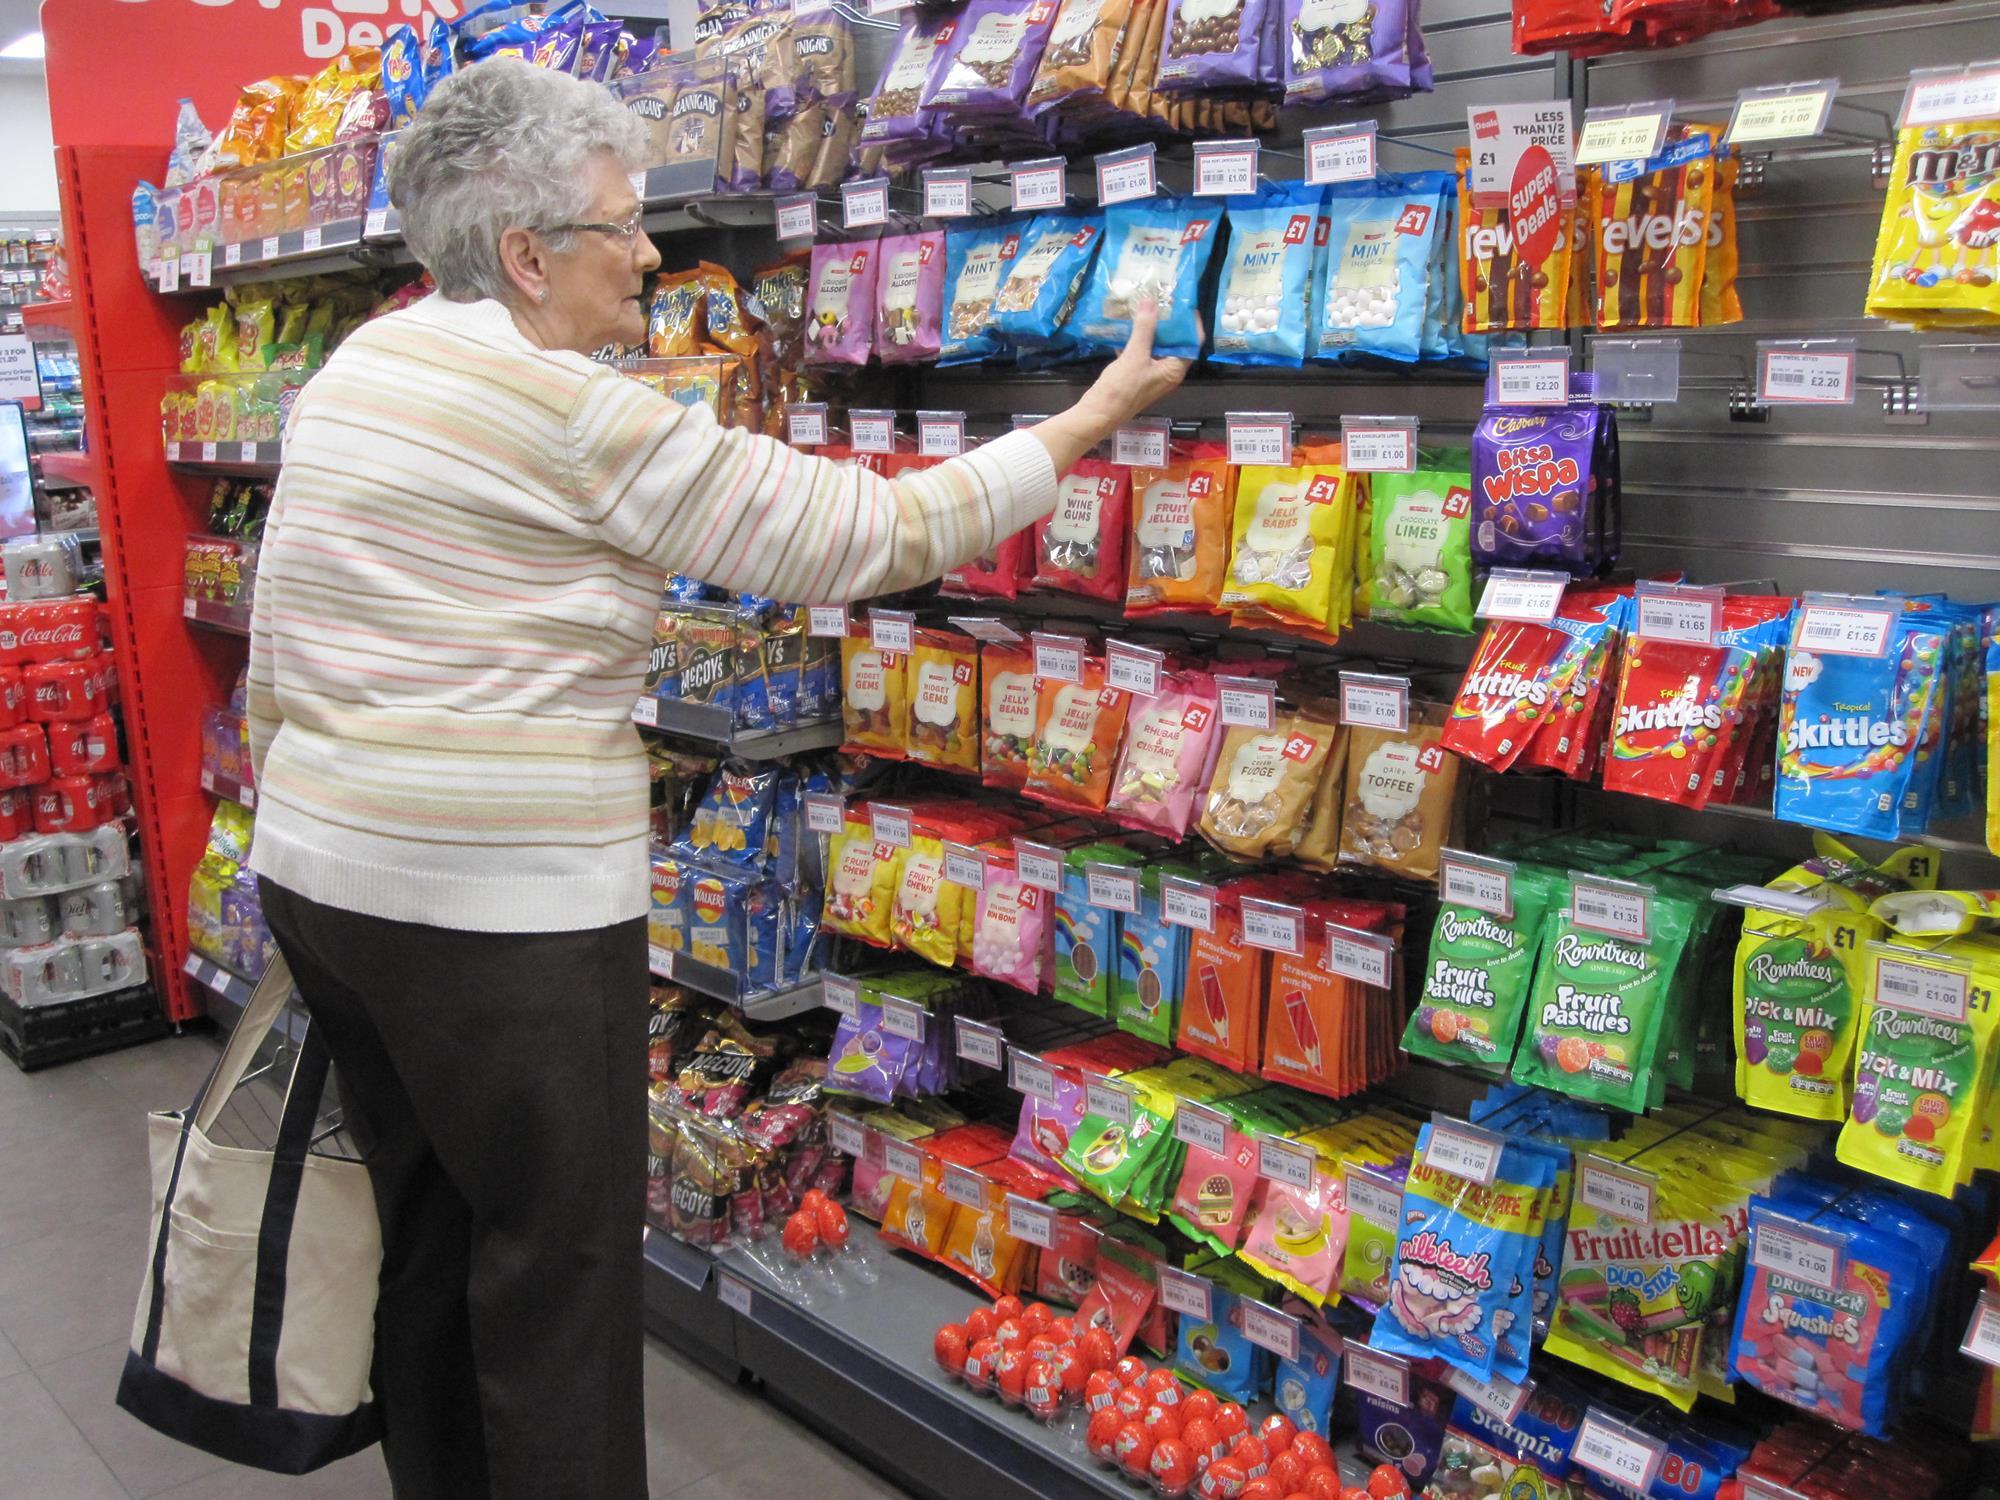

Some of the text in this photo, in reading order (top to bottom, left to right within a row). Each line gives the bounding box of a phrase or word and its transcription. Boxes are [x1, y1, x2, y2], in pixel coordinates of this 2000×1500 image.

[936, 26, 954, 42] £1
[976, 37, 1014, 46] RAISINS
[1534, 111, 1565, 123] LESS
[1780, 112, 1811, 125] £1.00
[1475, 119, 1499, 131] Deals
[1513, 123, 1566, 136] THAN 1/2
[1530, 135, 1566, 147] PRICE
[1620, 134, 1648, 146] £1.00
[1345, 154, 1368, 167] £1.00
[1479, 152, 1496, 166] £1
[1129, 177, 1147, 188] £1.00
[1228, 173, 1248, 183] £1.00
[1041, 185, 1058, 195] £1.00
[1512, 165, 1554, 217] SUPER
[950, 197, 965, 206] £1.00
[1398, 210, 1427, 231] £1
[1516, 194, 1558, 246] Deals
[1182, 223, 1204, 241] £1
[1286, 220, 1306, 239] £1
[1000, 240, 1018, 256] £1
[1132, 243, 1178, 259] MINT
[1351, 241, 1392, 258] MINT
[1242, 252, 1281, 268] MINT
[964, 260, 997, 276] MINT
[1535, 380, 1560, 391] £2.20
[1810, 377, 1841, 389] £2.20
[1492, 415, 1548, 437] Cadbury
[943, 437, 958, 447] £1.00
[1261, 444, 1281, 453] £1.00
[1144, 448, 1161, 456] £1.00
[1382, 450, 1405, 459] £1.00
[1497, 444, 1553, 472] Bitsa
[1099, 477, 1117, 496] £1
[1189, 477, 1211, 494] £1
[1483, 458, 1579, 505] Wispa
[1309, 480, 1335, 499] £1
[1066, 498, 1094, 511] WINE
[1155, 503, 1189, 513] FRUIT
[1445, 491, 1470, 513] £1
[1063, 510, 1093, 522] GUMS
[1147, 514, 1190, 524] JELLIES
[1399, 515, 1440, 526] CHOCOLATE
[1394, 524, 1439, 541] LIMES
[1526, 599, 1551, 609] £1.65
[1679, 619, 1706, 631] £1.65
[20, 623, 84, 646] Coca-Cola
[893, 634, 908, 644] £1.00
[1846, 630, 1877, 643] £1.65
[954, 667, 970, 682] £1
[1060, 662, 1077, 672] £1.00
[1791, 664, 1816, 678] NEW
[855, 671, 881, 680] MIDGET
[1133, 673, 1151, 685] £1.00
[854, 680, 880, 691] GEMS
[923, 683, 950, 694] MIDGET
[922, 693, 949, 705] GEMS
[1002, 694, 1030, 705] JELLY
[1099, 687, 1119, 706] £1
[999, 704, 1030, 716] BEANS
[1064, 707, 1092, 720] JELLY
[1249, 709, 1267, 720] £1.00
[1375, 706, 1396, 718] £1.00
[1831, 702, 1872, 713] Tropical
[1059, 717, 1089, 731] BEANS
[1183, 709, 1207, 728] £1
[1784, 715, 1908, 755] Skittles
[1136, 740, 1175, 758] CUSTARD
[1288, 738, 1313, 758] £1
[1419, 748, 1444, 768] £1
[1240, 765, 1276, 778] FUDGE
[1382, 765, 1407, 776] DAIRY
[1367, 773, 1416, 793] TOFFEE
[844, 856, 872, 867] FRUITY
[1907, 856, 1931, 878] £1
[842, 865, 869, 877] CHEWS
[908, 870, 937, 885] FRUITY
[966, 870, 982, 882] £1.00
[1041, 870, 1058, 882] £0.45
[905, 879, 935, 895] CHEWS
[693, 886, 726, 906] WALKERS
[1114, 891, 1132, 903] £0.45
[1480, 890, 1503, 902] £1.35
[999, 912, 1017, 925] BONS
[1190, 909, 1208, 922] £0.45
[1613, 910, 1639, 924] £1.35
[1271, 927, 1293, 942] £0.45
[1438, 909, 1515, 947] Rowntrees
[1834, 927, 1857, 950] £1
[1486, 957, 1501, 968] love
[1507, 947, 1526, 963] share
[1553, 933, 1648, 970] Rowntrees
[1361, 961, 1383, 976] £0.45
[1434, 959, 1490, 991] Fruit
[1749, 952, 1834, 984] Rowntrees
[1280, 975, 1313, 991] pencils
[1617, 981, 1633, 993] love
[1640, 969, 1658, 987] share
[1556, 984, 1622, 1015] Fruit
[1926, 989, 1957, 1004] £1.00
[1968, 986, 1992, 1013] £1
[1542, 1002, 1632, 1035] Pastilles
[1782, 1007, 1794, 1021] &
[1794, 1006, 1838, 1031] Mix
[1870, 1007, 1959, 1046] Rowntrees
[1898, 1066, 1911, 1081] &
[1910, 1066, 1959, 1097] Mix
[1203, 1132, 1222, 1146] £0.45
[1462, 1156, 1486, 1170] £1.00
[1287, 1167, 1307, 1182] £0.45
[1412, 1163, 1443, 1187] 40%
[1378, 1203, 1398, 1218] £0.45
[1620, 1196, 1645, 1213] £1.00
[1399, 1231, 1438, 1265] milk
[1436, 1240, 1492, 1290] teeth
[1797, 1255, 1827, 1275] £1.00
[1605, 1264, 1646, 1288] DUO
[1641, 1264, 1682, 1302] STIX
[1860, 1269, 1888, 1299] NEW
[1770, 1274, 1867, 1318] DRUMSTICK
[1378, 1377, 1400, 1393] £0.45
[1366, 1395, 1401, 1415] raisins
[1486, 1390, 1511, 1412] £1.39
[1470, 1402, 1564, 1464] Starmix
[1615, 1455, 1642, 1475] £1.39
